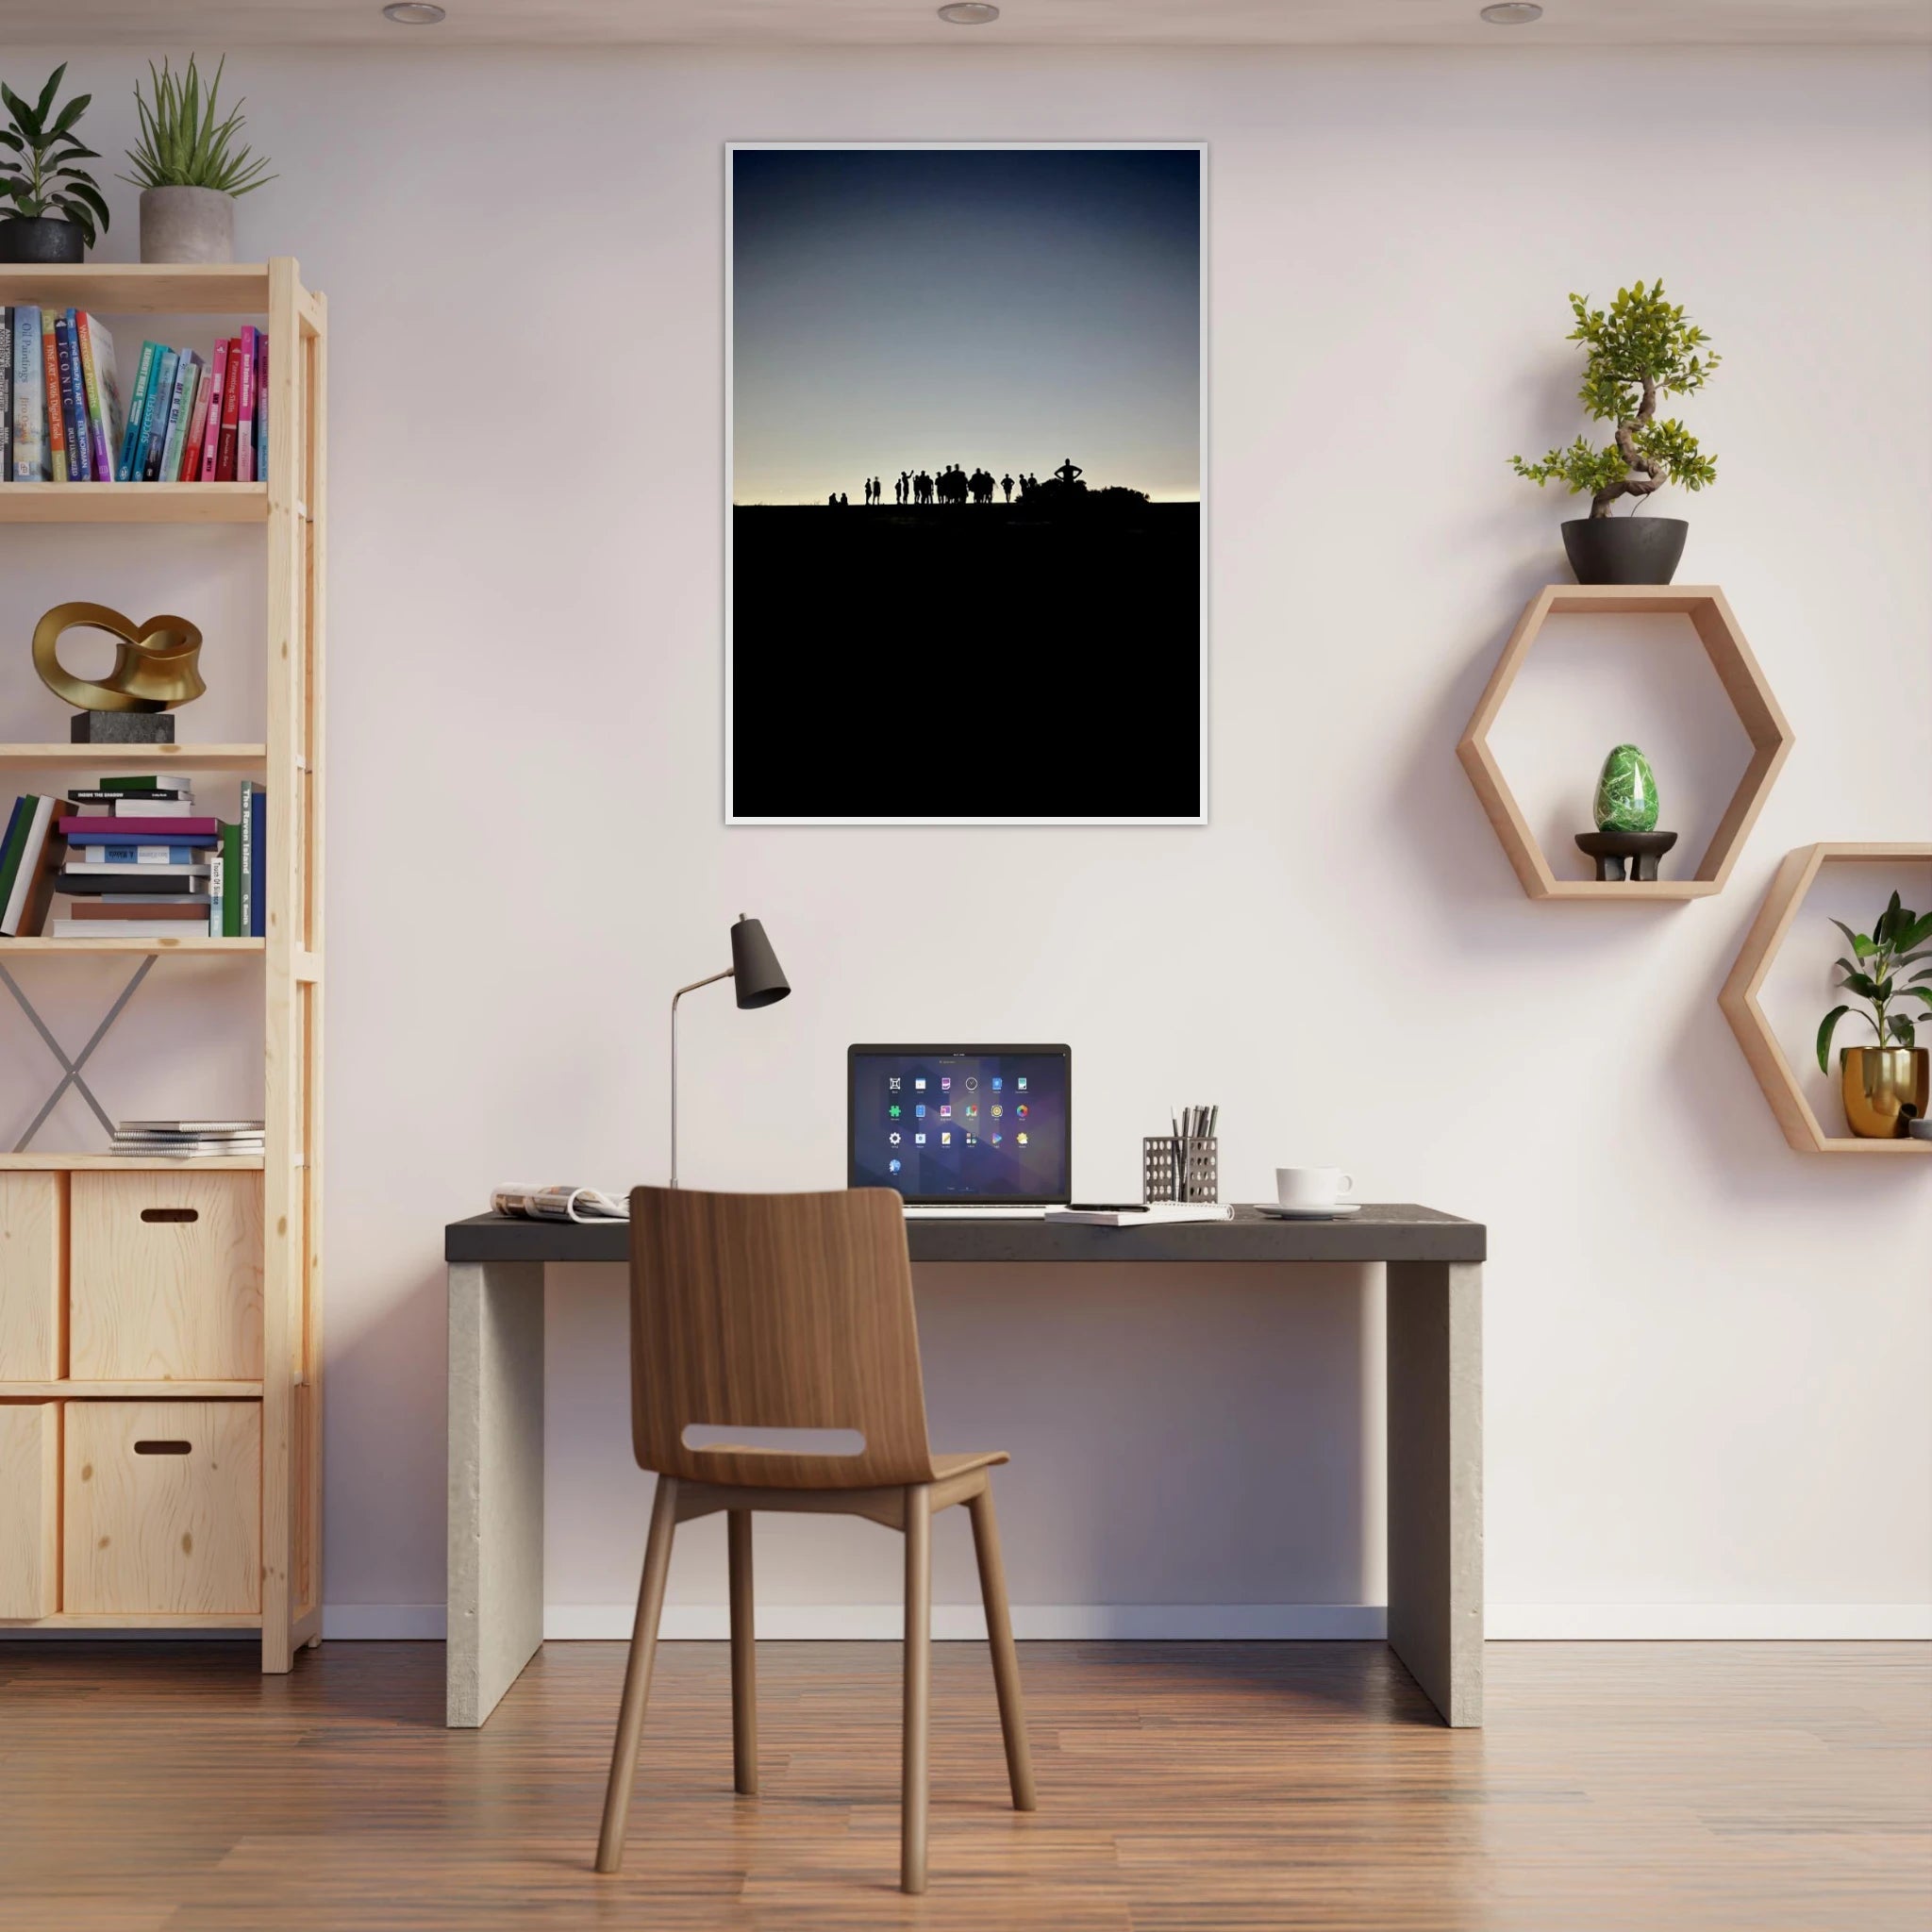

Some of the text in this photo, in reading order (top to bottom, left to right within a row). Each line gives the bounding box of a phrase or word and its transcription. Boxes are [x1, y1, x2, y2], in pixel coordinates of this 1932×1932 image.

[19, 323, 32, 383] Oil Paintings
[46, 344, 56, 360] FINE
[48, 361, 57, 377] ART
[58, 341, 73, 405] ICONIC
[79, 325, 97, 408] Watercolor Portraits
[49, 382, 58, 398] With
[227, 360, 239, 412] Parenting Skills
[50, 400, 59, 422] Digital
[53, 423, 61, 440] Tools
[78, 437, 89, 469] NORMAN
